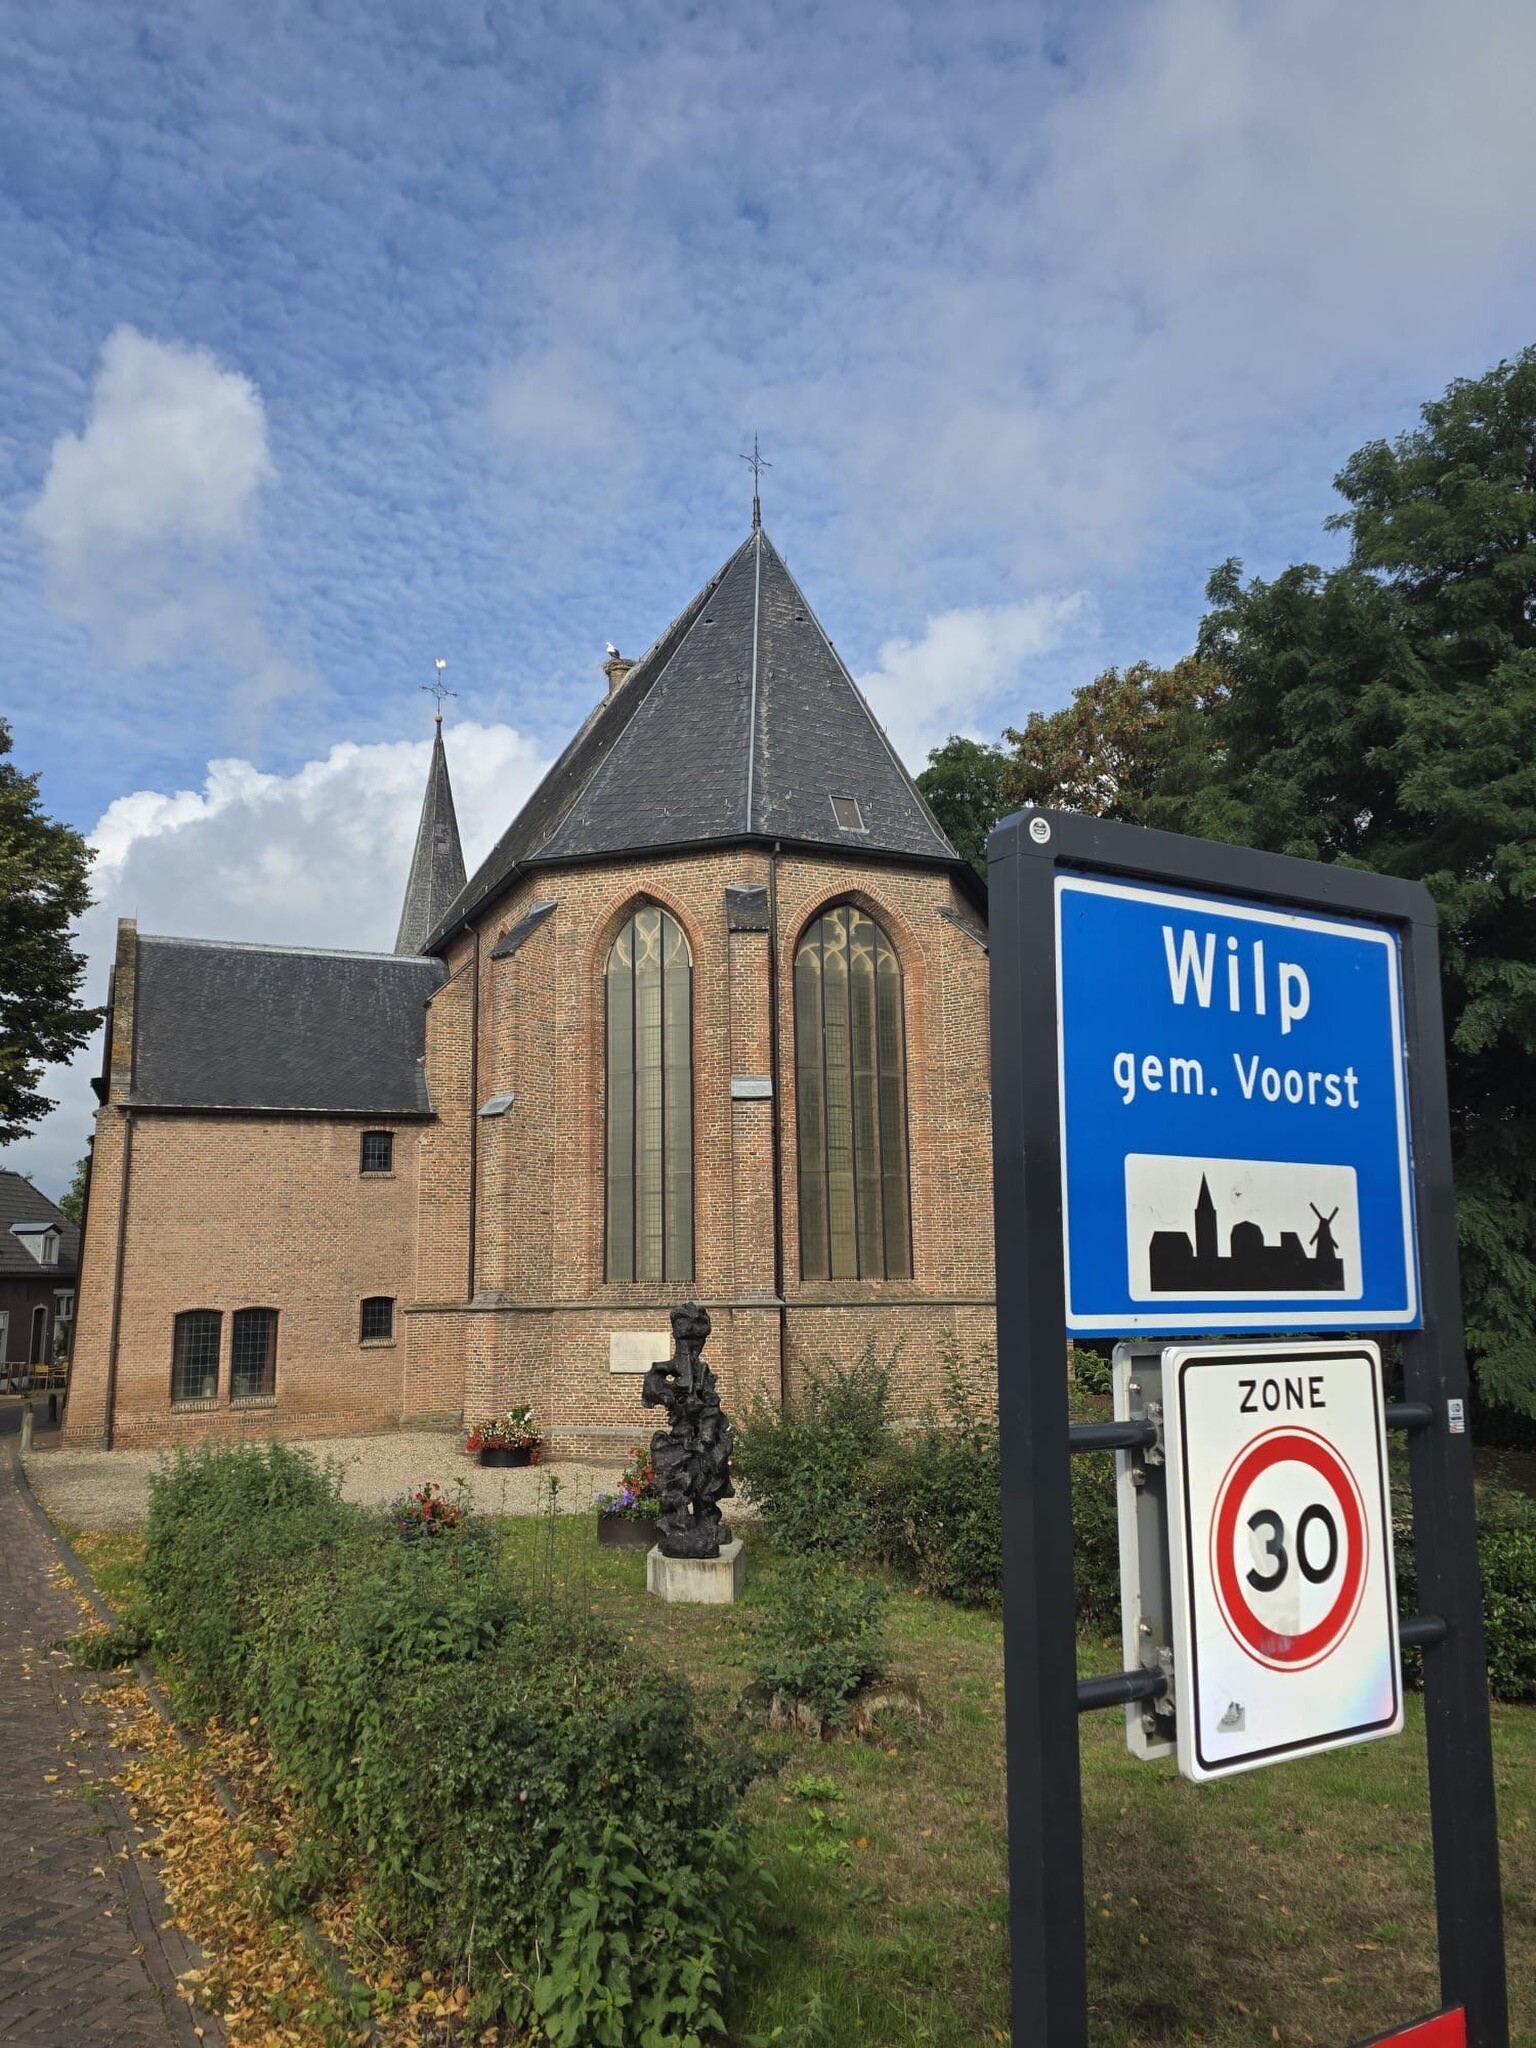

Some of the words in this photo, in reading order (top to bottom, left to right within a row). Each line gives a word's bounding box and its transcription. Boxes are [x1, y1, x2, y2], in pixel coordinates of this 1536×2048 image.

[1162, 926, 1310, 1035] Wilp
[1114, 1052, 1218, 1105] gem.
[1233, 1053, 1360, 1109] Voorst
[1238, 1376, 1327, 1414] ZONE
[1246, 1503, 1338, 1593] 30
